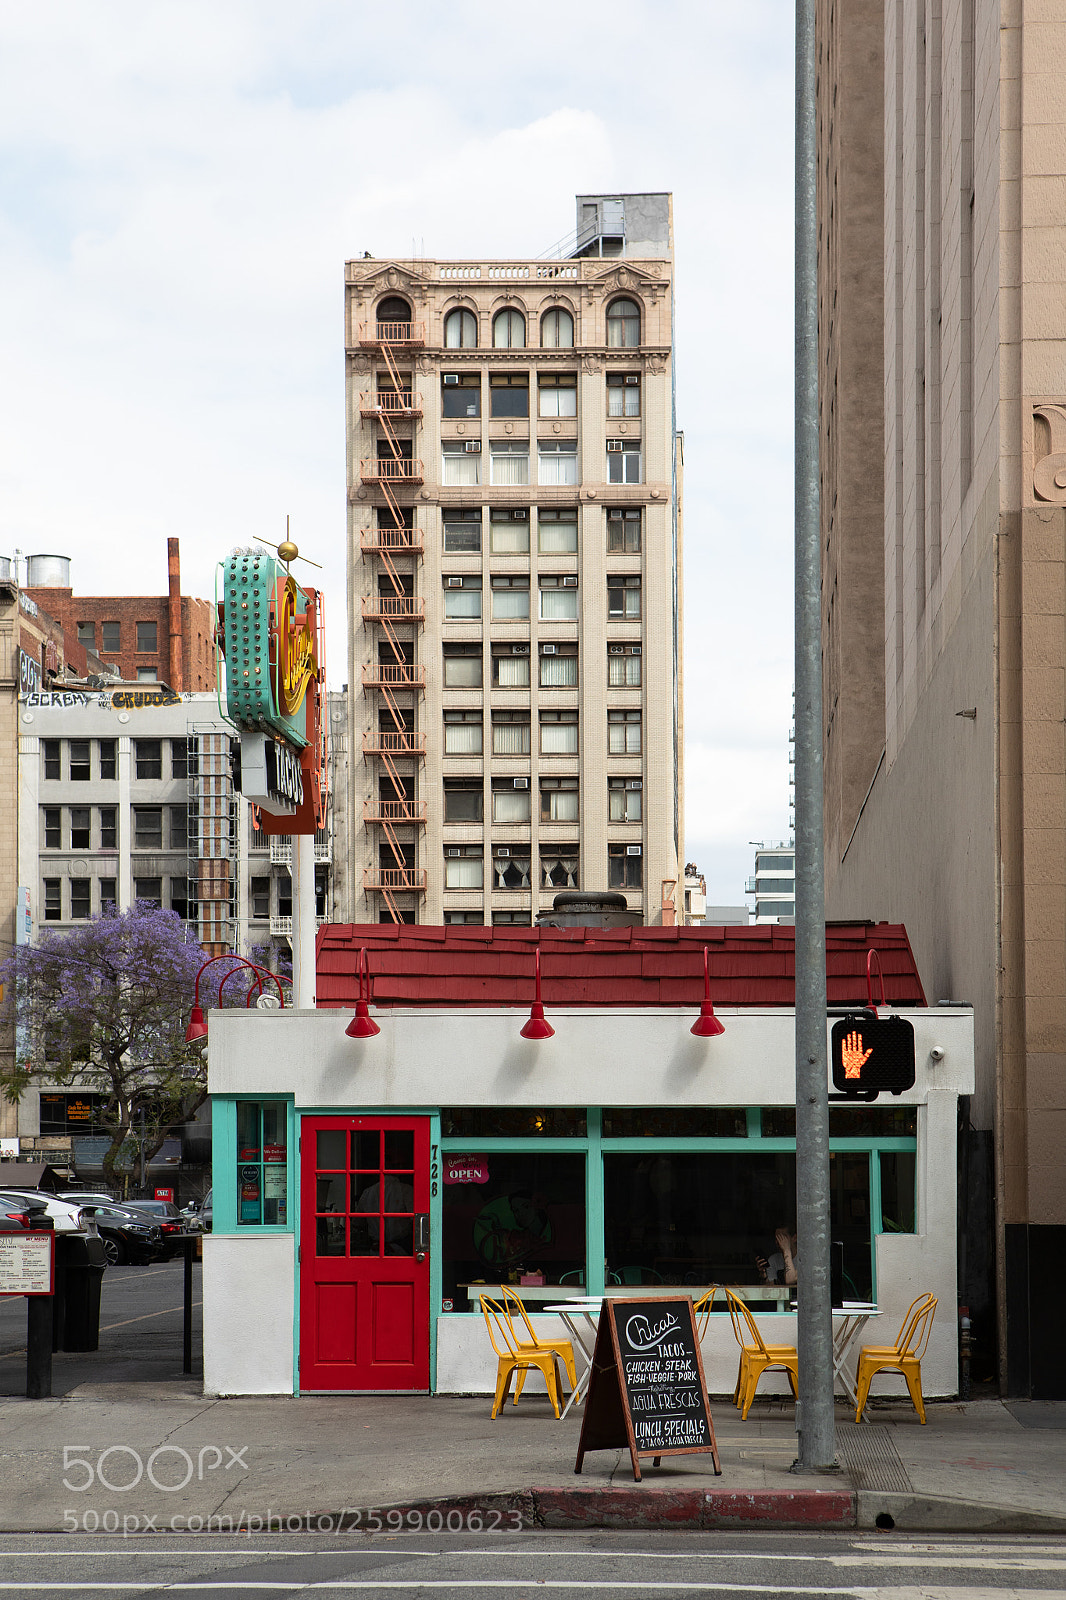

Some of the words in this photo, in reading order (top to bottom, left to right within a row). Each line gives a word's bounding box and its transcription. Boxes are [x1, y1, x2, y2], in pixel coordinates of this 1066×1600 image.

[112, 692, 182, 710] CRUDOZ
[274, 741, 304, 805] TACOS
[448, 1158, 466, 1168] Come
[449, 1169, 482, 1179] OPEN
[626, 1313, 682, 1351] Chicas
[657, 1342, 685, 1358] TACOS
[626, 1361, 661, 1374] CHICKEN
[665, 1359, 692, 1371] STEAK
[678, 1370, 697, 1381] PORK
[632, 1394, 657, 1411] AGUA
[658, 1391, 701, 1410] FRESCAS
[635, 1420, 662, 1438] LUNCH
[664, 1419, 705, 1437] SPECIALS
[640, 1439, 646, 1448] 2
[646, 1437, 665, 1448] TACOS
[668, 1436, 684, 1446] AGUA
[684, 1435, 704, 1445] FRESCA
